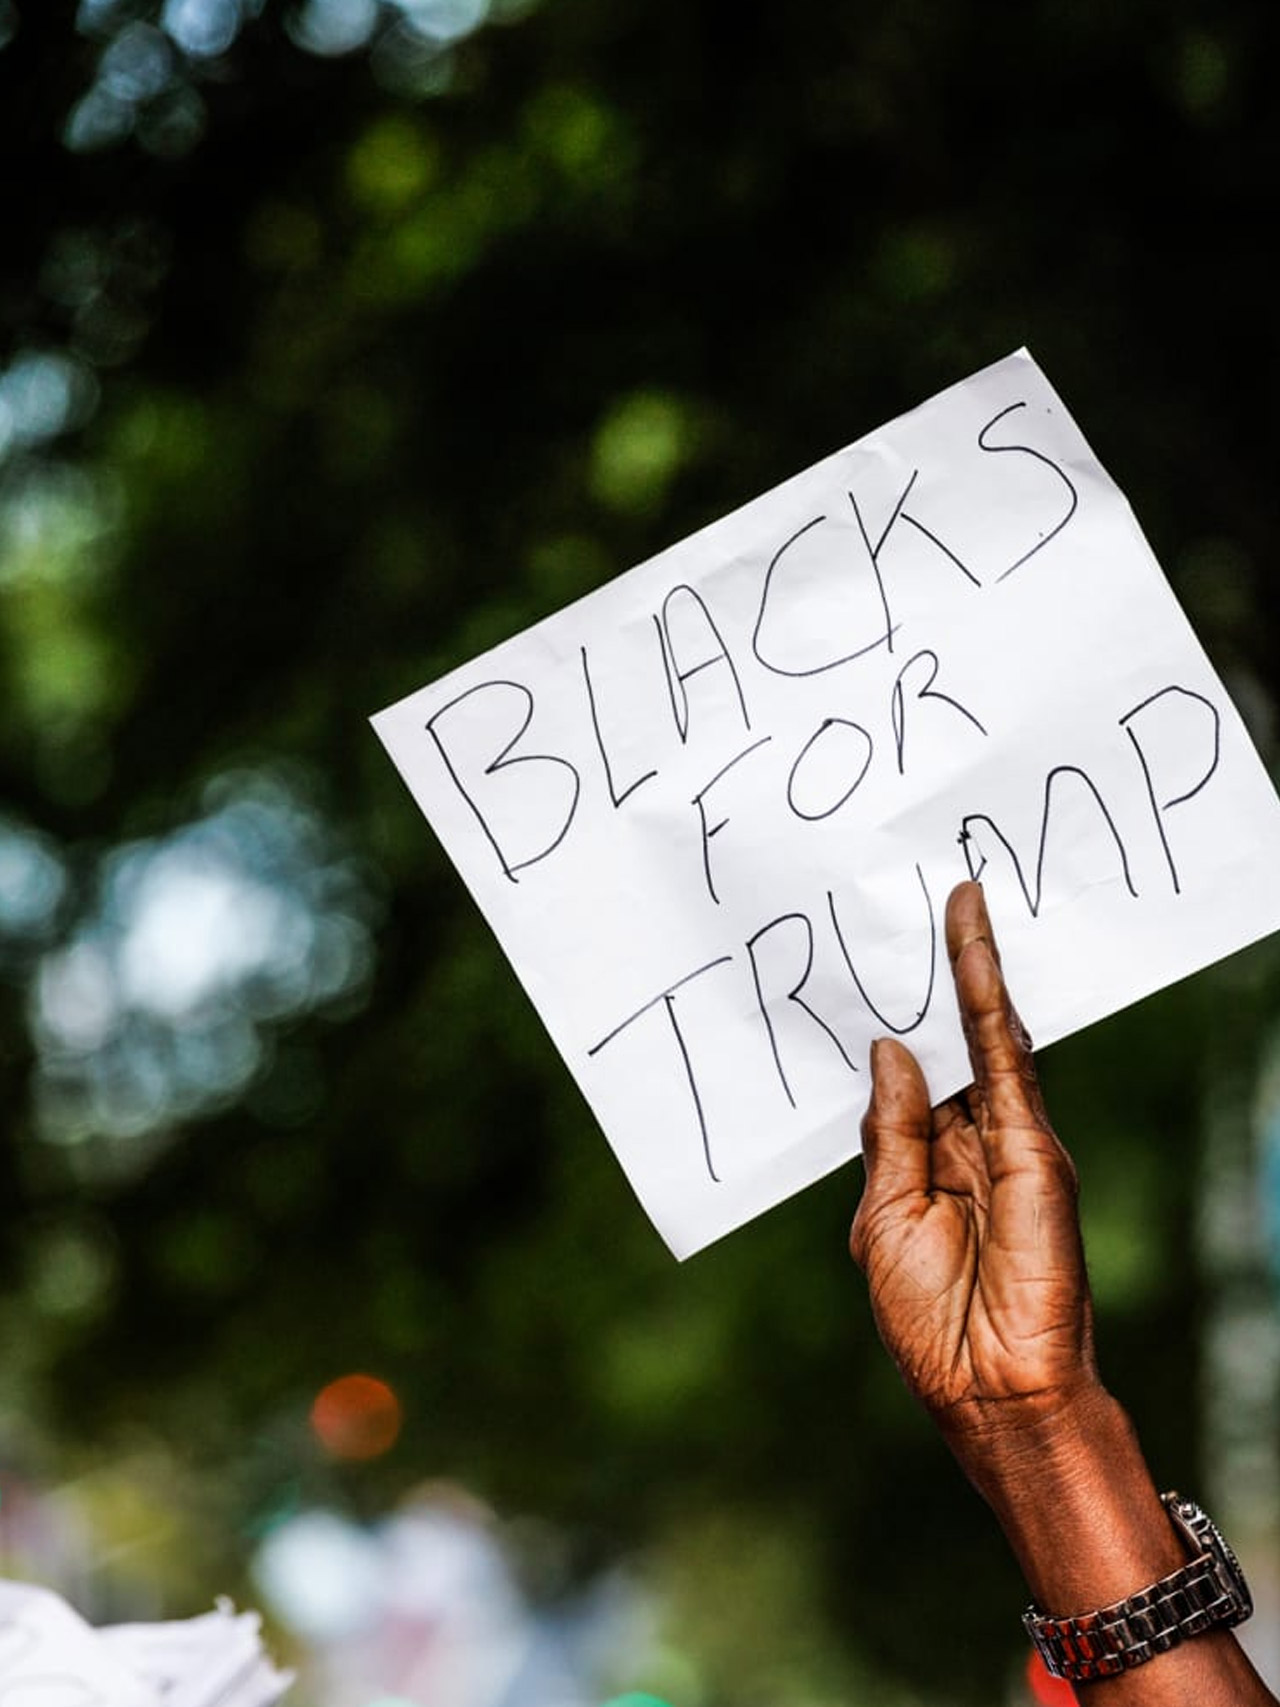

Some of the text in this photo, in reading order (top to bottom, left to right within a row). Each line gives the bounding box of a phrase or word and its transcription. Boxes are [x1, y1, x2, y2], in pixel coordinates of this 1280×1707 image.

[426, 402, 1077, 883] BLACKS
[692, 650, 987, 904] FOR
[588, 686, 1219, 1182] TRUMP
